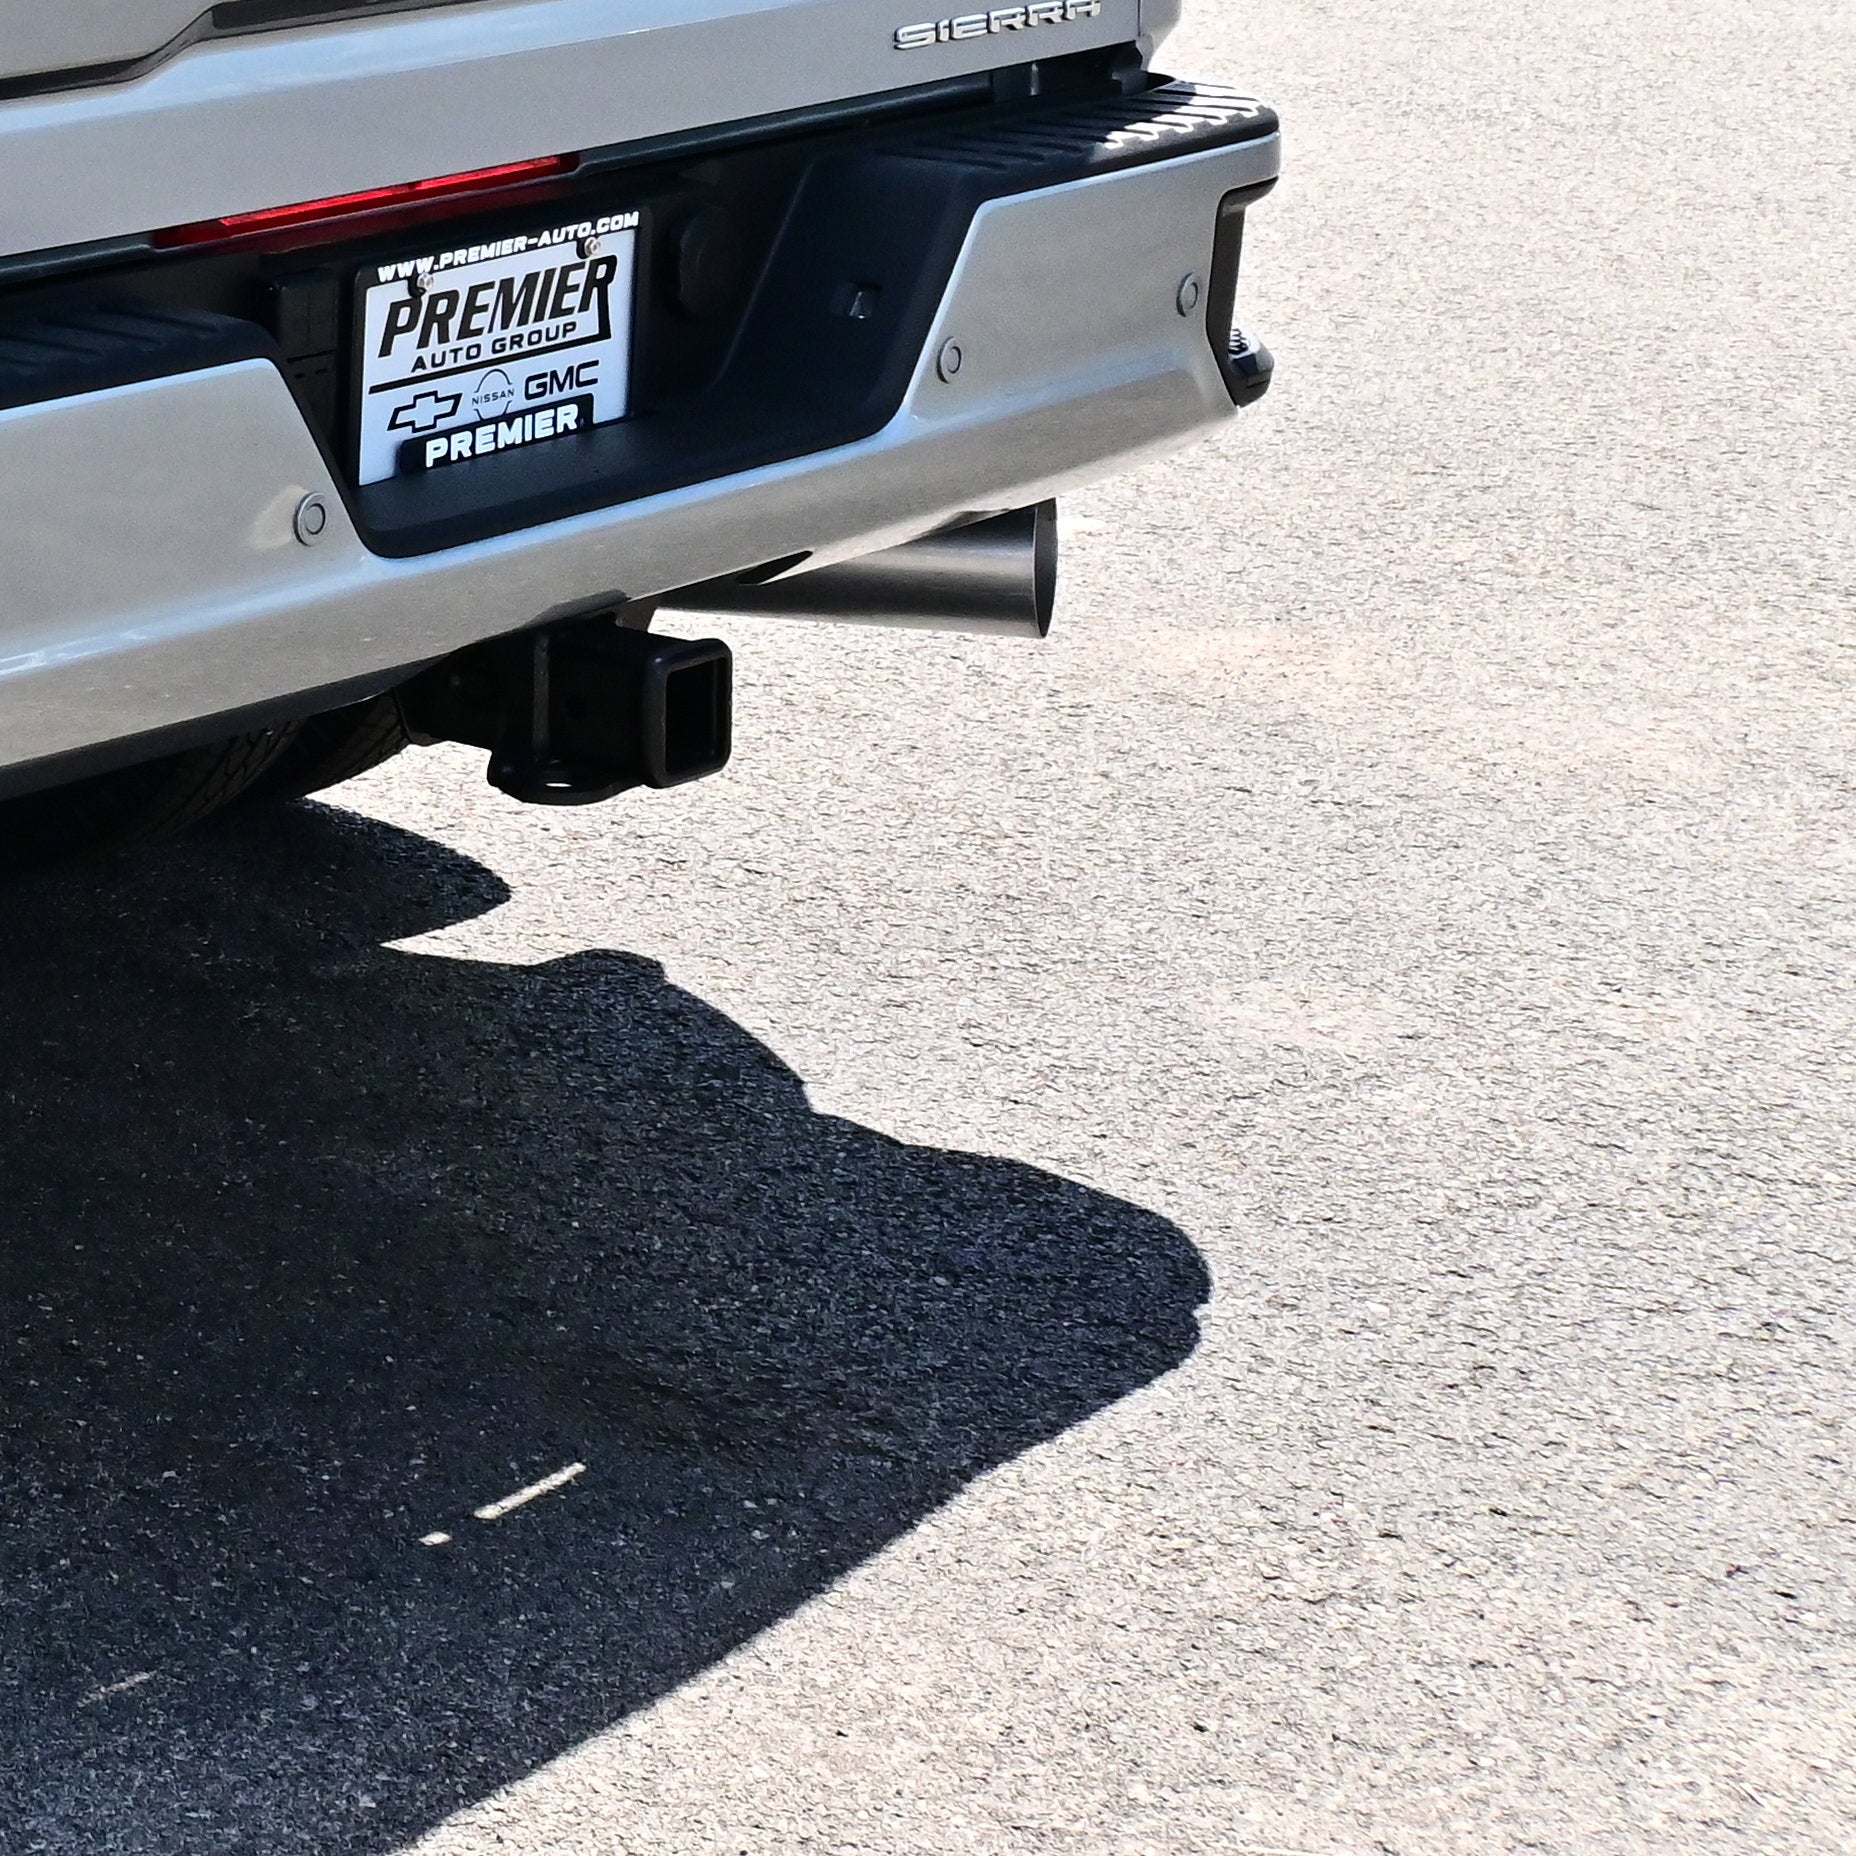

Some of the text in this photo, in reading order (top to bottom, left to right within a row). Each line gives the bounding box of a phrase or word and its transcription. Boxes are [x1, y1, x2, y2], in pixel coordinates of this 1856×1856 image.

[377, 211, 640, 283] WWW.PREMIER-AUTO.COM
[378, 254, 618, 358] PREMIER
[411, 321, 577, 373] AUTO GROUP
[472, 360, 600, 406] NISSAN GMC
[425, 403, 579, 468] PREMIER
